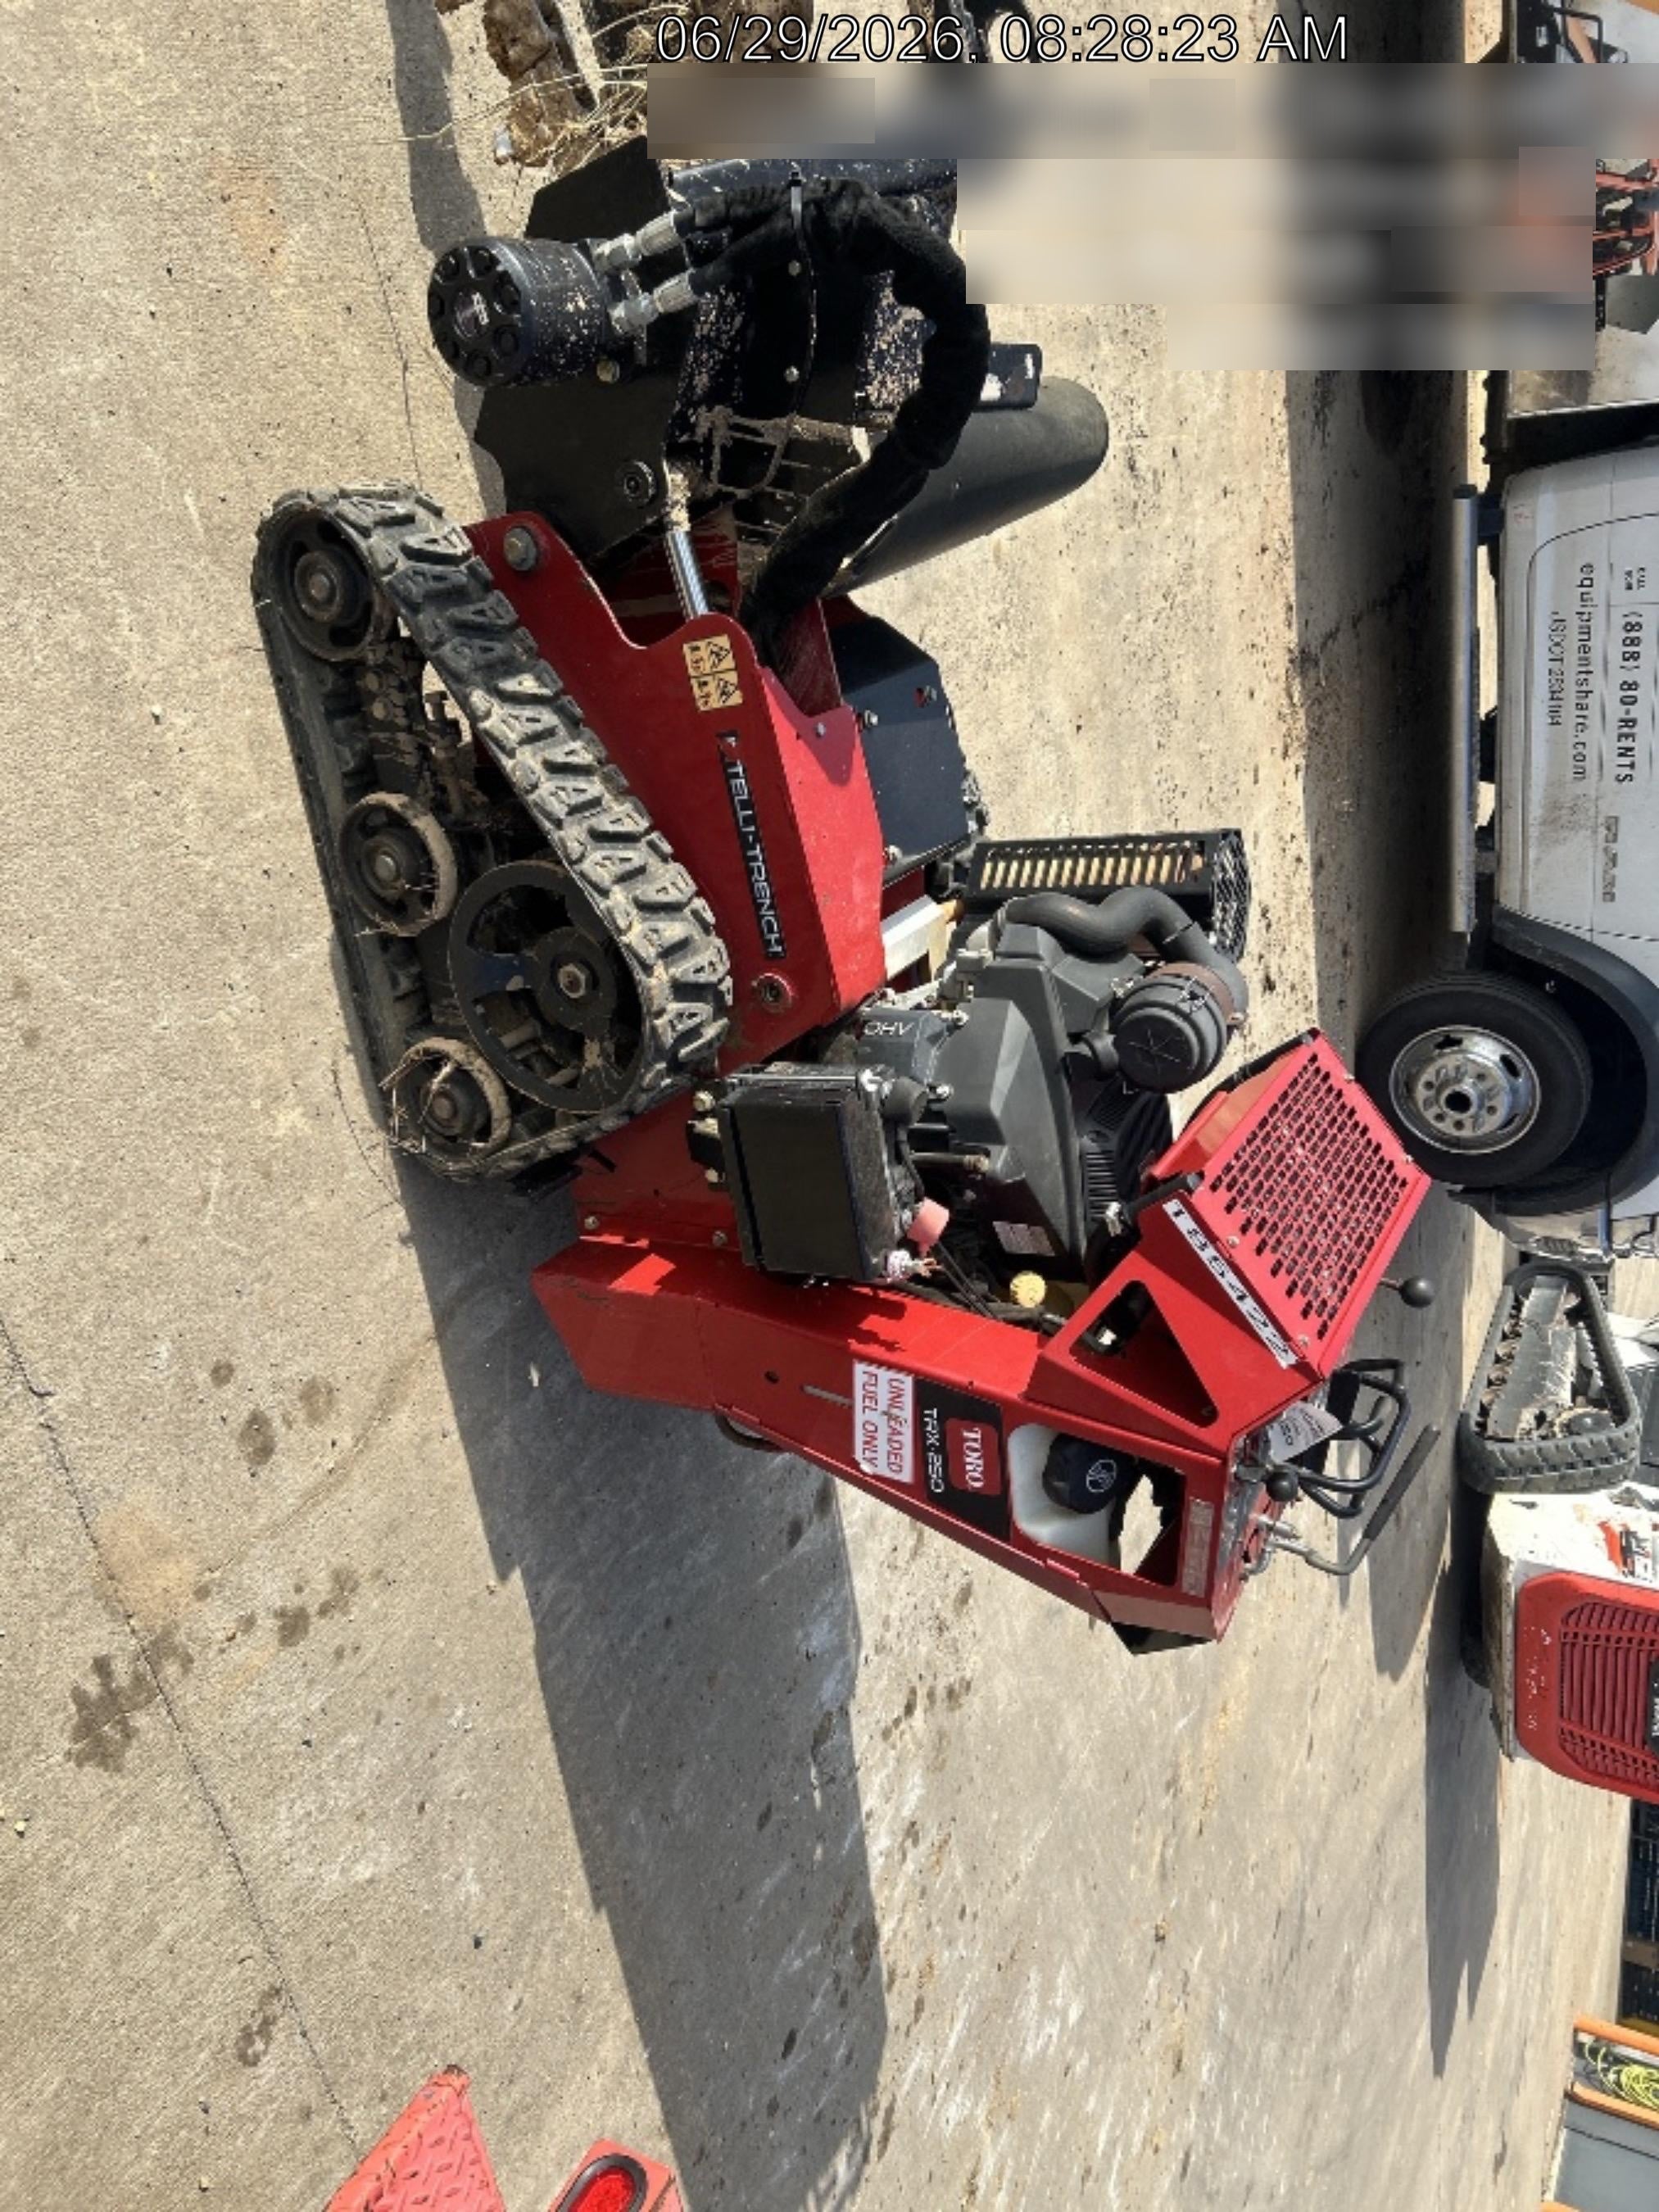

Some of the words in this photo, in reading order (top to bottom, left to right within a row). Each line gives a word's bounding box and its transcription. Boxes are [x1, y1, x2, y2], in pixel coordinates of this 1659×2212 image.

[1573, 563, 1598, 782] equipmentshare.com
[1620, 612, 1643, 671] (888)
[1615, 679, 1639, 785] 80-RENTS
[726, 737, 783, 953] ITELLI-TRENCH
[862, 1371, 879, 1414] FUEL
[887, 1377, 905, 1475] UNLEADED
[862, 1421, 878, 1468] ONLY
[962, 1427, 984, 1488] TORO
